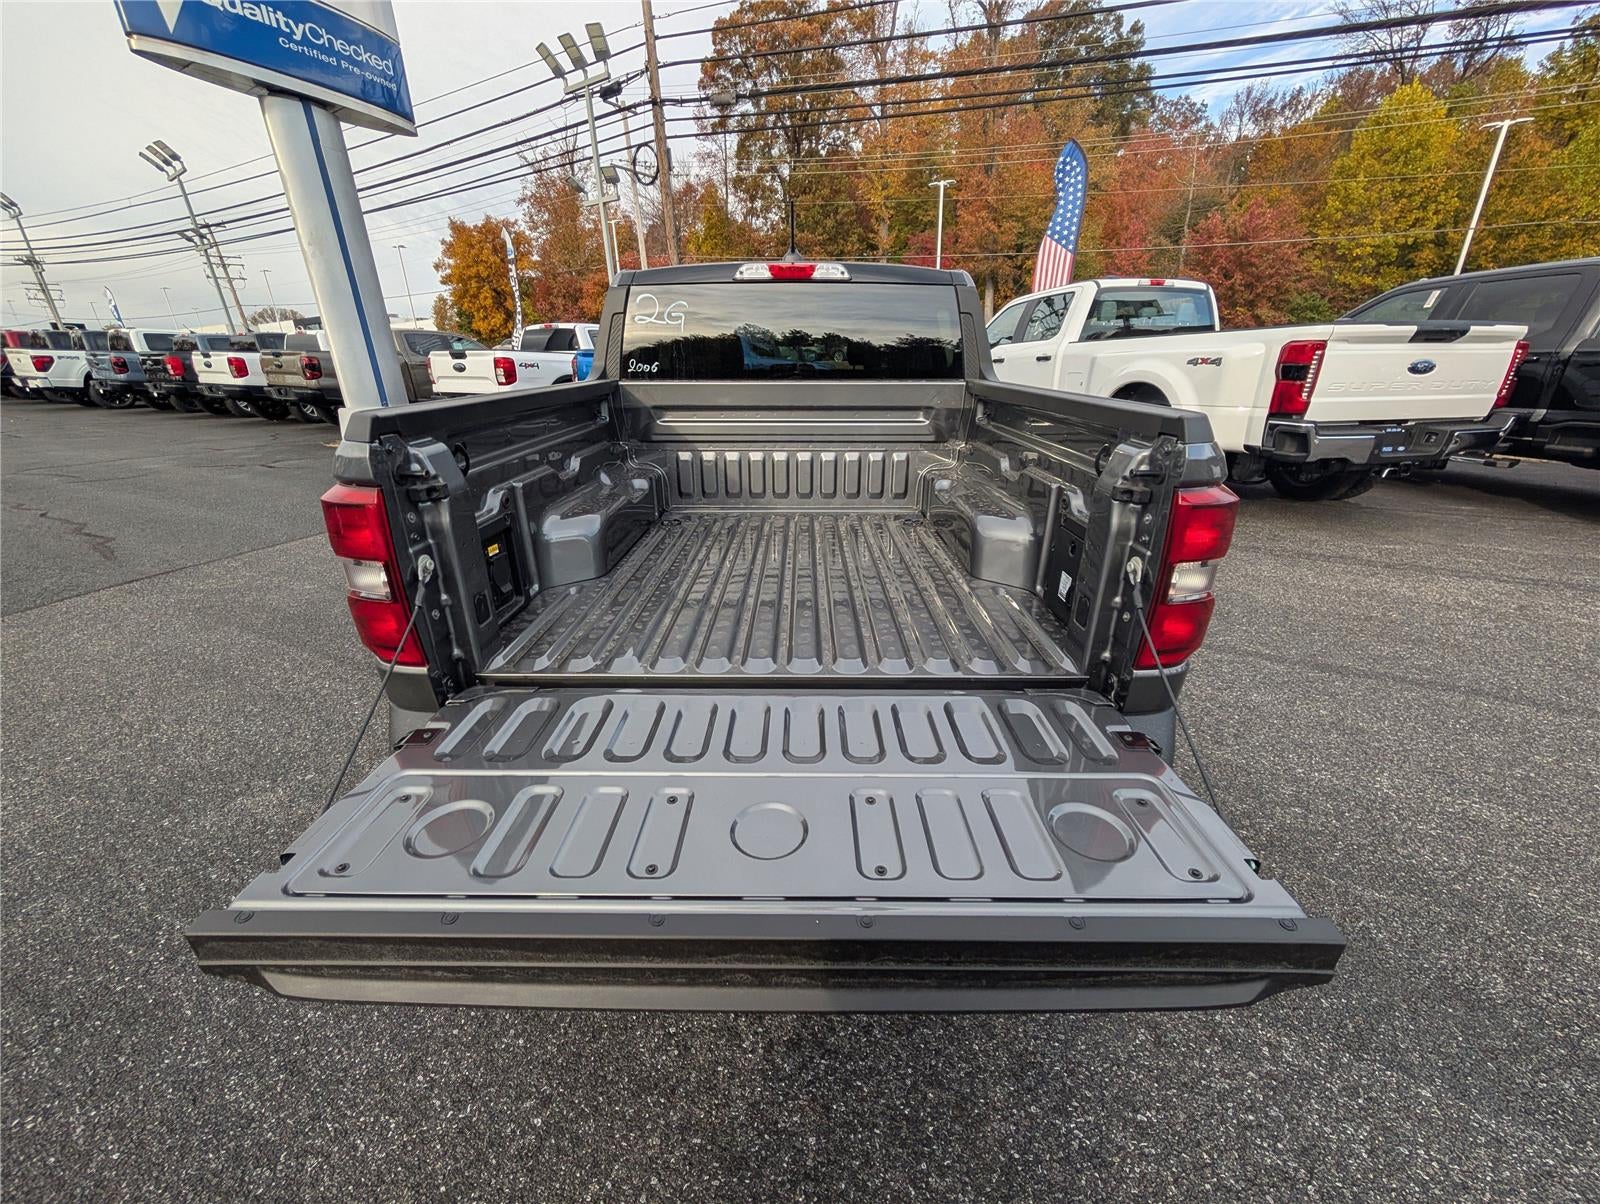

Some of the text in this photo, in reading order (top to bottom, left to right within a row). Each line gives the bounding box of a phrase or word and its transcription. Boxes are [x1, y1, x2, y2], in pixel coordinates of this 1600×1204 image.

[279, 37, 397, 91] Certified Pre-owned
[627, 358, 660, 373] 2006
[1327, 379, 1496, 392] SUPER DUTY
